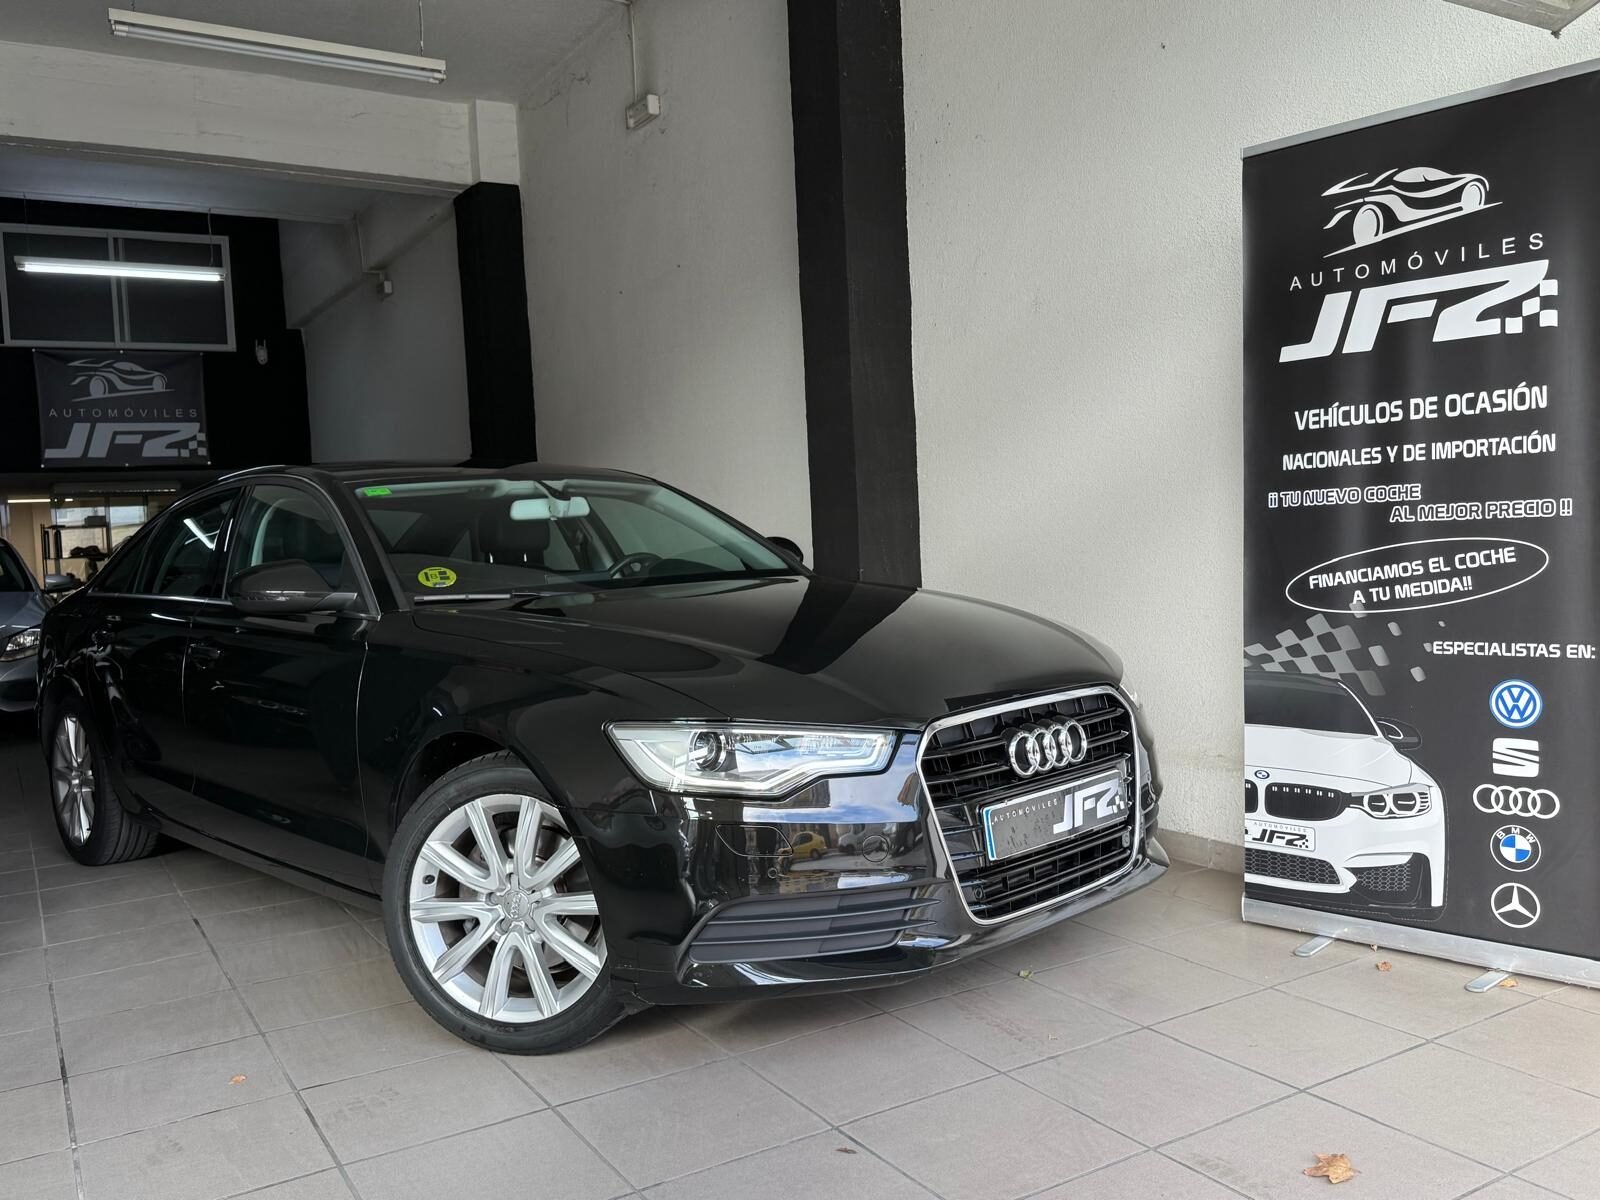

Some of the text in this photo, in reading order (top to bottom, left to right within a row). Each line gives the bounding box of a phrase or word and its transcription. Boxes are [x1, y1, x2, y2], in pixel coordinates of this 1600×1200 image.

[1290, 232, 1544, 291] AUTOMÓVILES
[1279, 259, 1550, 362] JFZ
[49, 407, 198, 418] AUTOMÓVILES
[1295, 381, 1548, 431] VEHÍCULOS DE OCASIÓN
[44, 422, 201, 458] JFZ
[1282, 430, 1556, 471] NACIONALES Y DE IMPORTACIÓN
[1303, 486, 1361, 506] NUEVO
[1364, 483, 1421, 503] COCHE
[1390, 504, 1415, 523] AL
[1417, 501, 1481, 522] MEJOR
[1485, 498, 1556, 520] PRECIO
[1309, 546, 1517, 589] FINANCIAMOS EL COCHE
[1352, 575, 1473, 605] A TU MEDIDA!!
[1432, 640, 1596, 660] ESPECIALISTAS EN:
[1053, 777, 1121, 834] JFZ
[1252, 828, 1307, 848] JFZ
[1496, 826, 1536, 844] BMW
